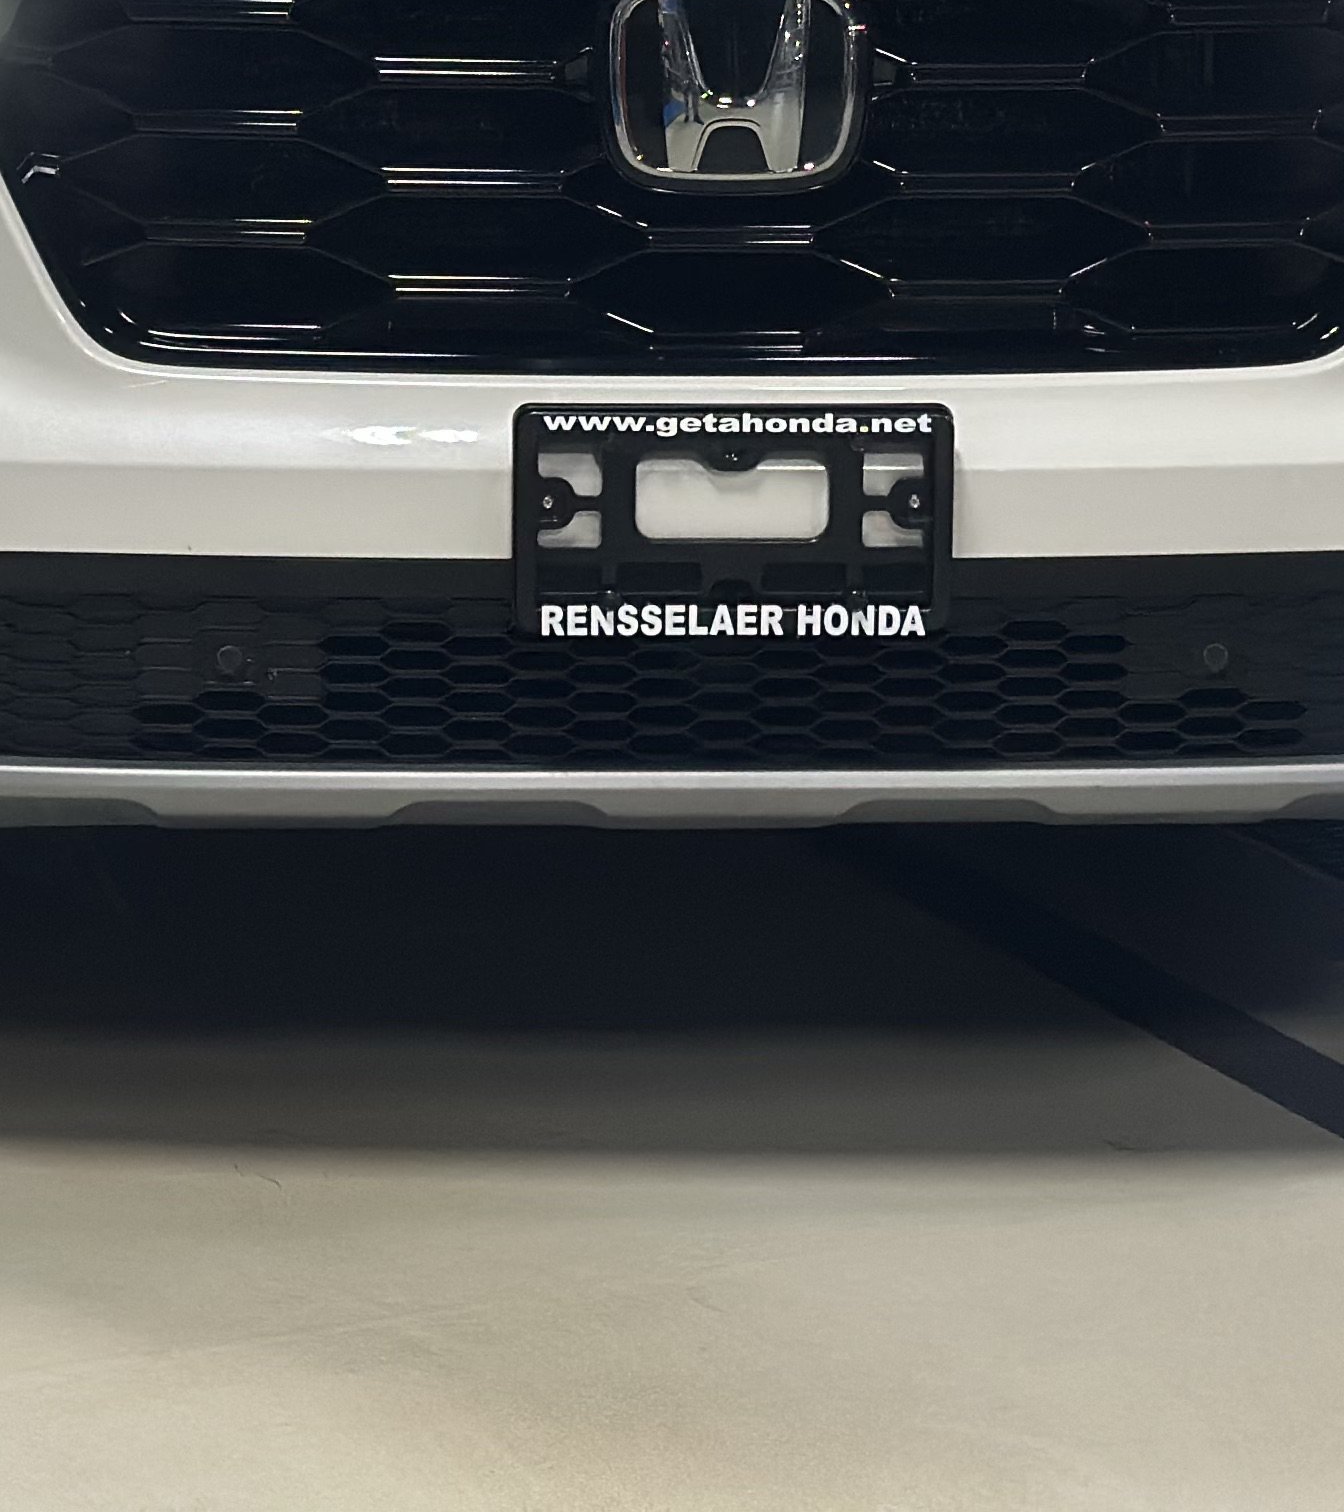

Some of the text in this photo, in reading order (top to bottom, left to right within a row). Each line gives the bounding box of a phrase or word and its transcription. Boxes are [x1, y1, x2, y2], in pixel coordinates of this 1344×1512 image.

[542, 411, 933, 438] www.getahonda.net
[540, 603, 927, 637] RENSSELAER HONDA
